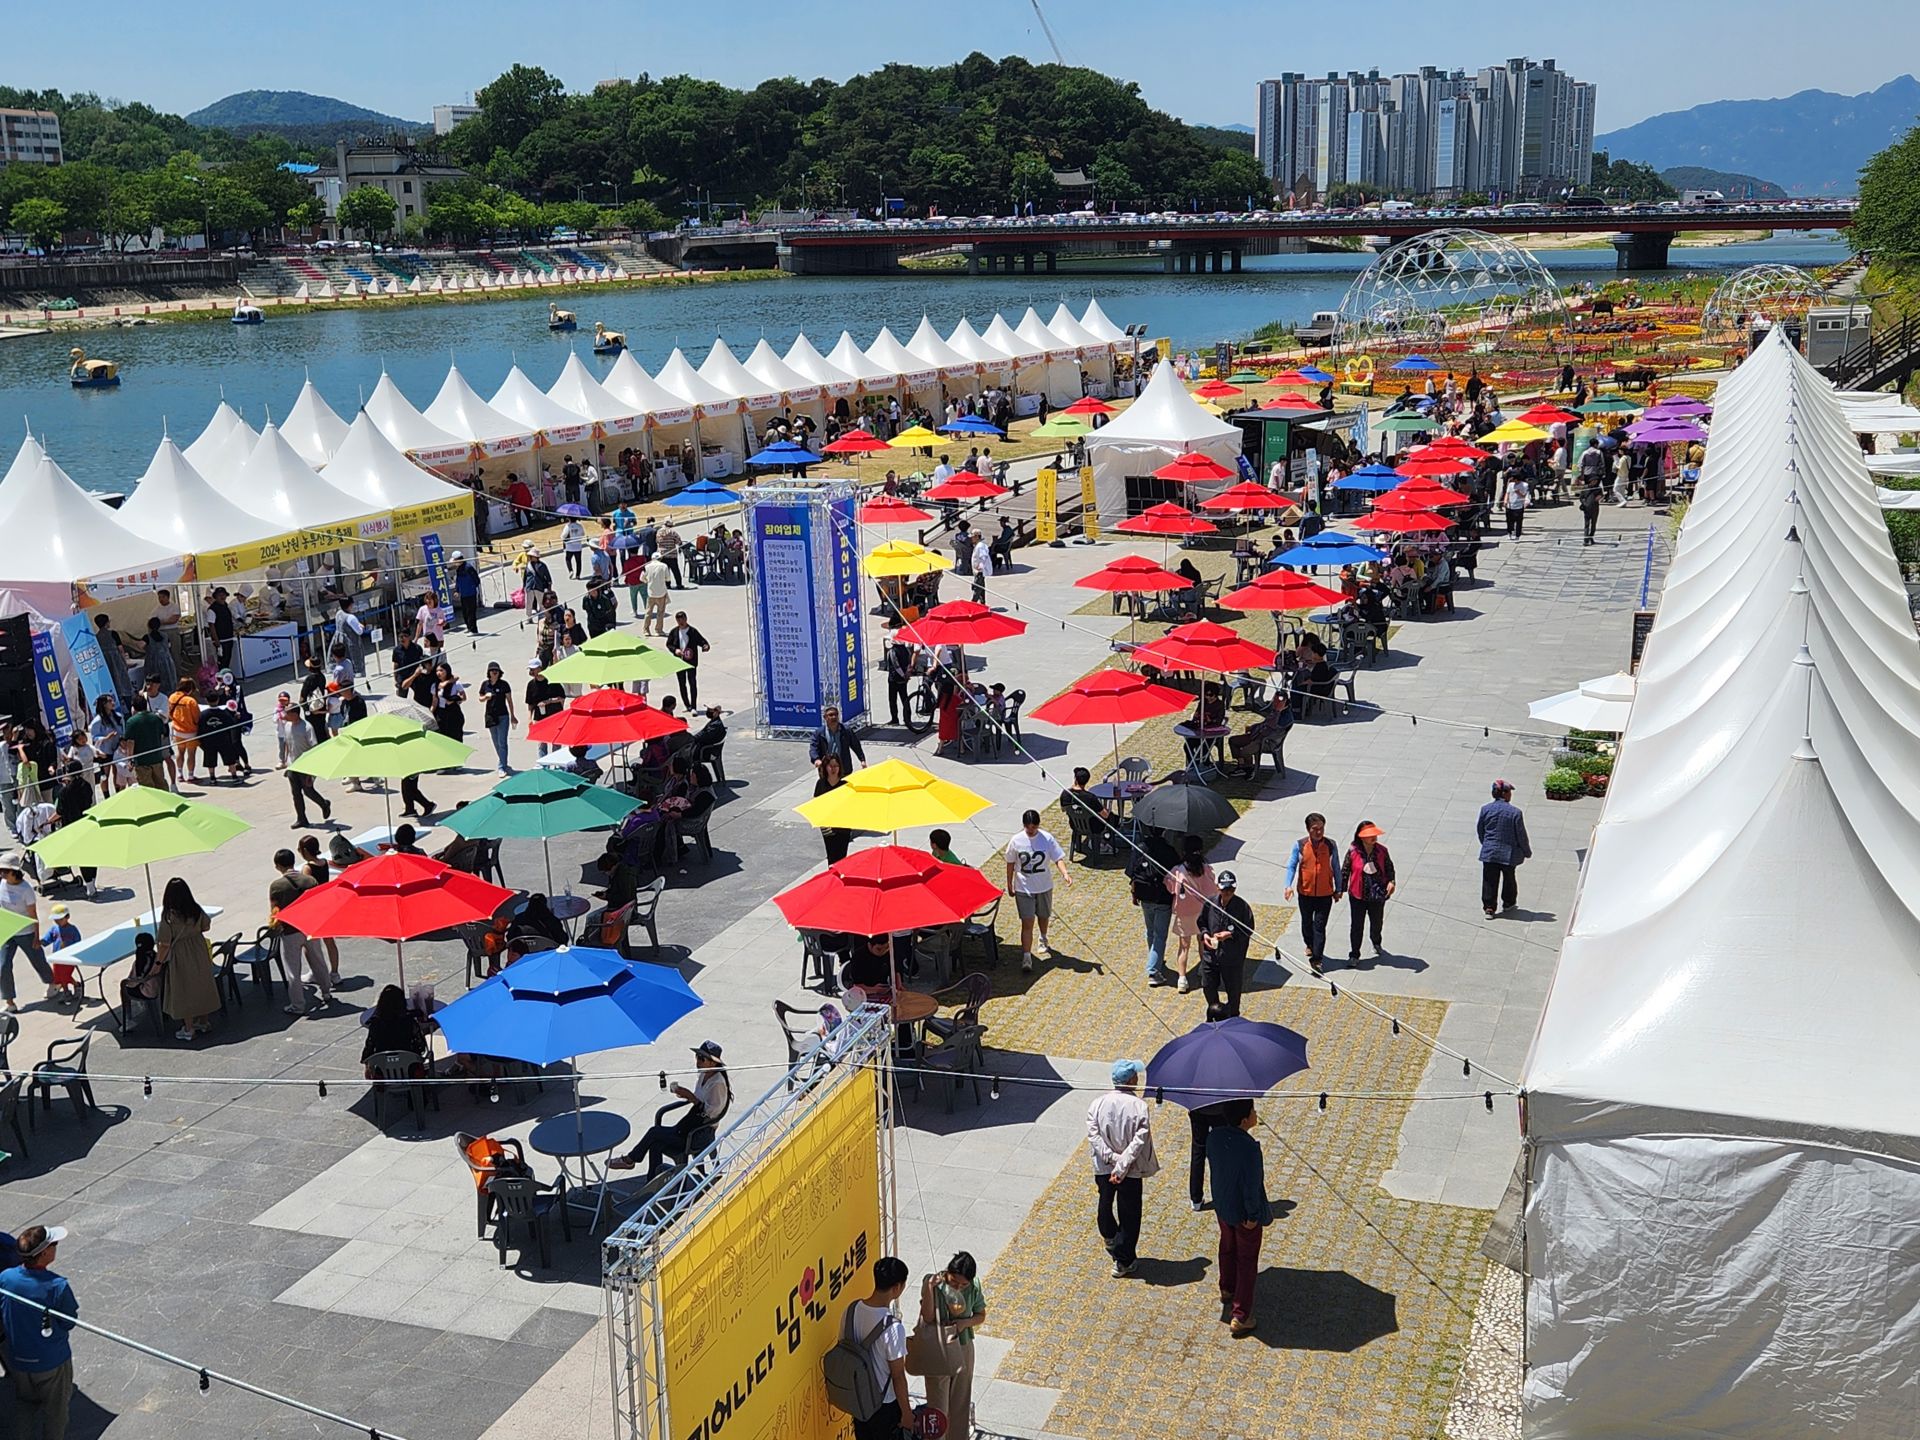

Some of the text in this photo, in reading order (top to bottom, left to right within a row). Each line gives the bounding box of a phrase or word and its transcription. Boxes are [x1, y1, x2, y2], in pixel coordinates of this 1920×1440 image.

[260, 544, 280, 560] 2024
[282, 537, 299, 554] 남원
[336, 526, 352, 544] 축제
[361, 519, 390, 534] 시식행사
[764, 524, 802, 536] 참여업체
[432, 552, 450, 604] 무료시식
[42, 654, 68, 725] 이벤트
[846, 632, 857, 702] 농산물
[1018, 851, 1046, 874] 22
[830, 1230, 868, 1301] 농산물
